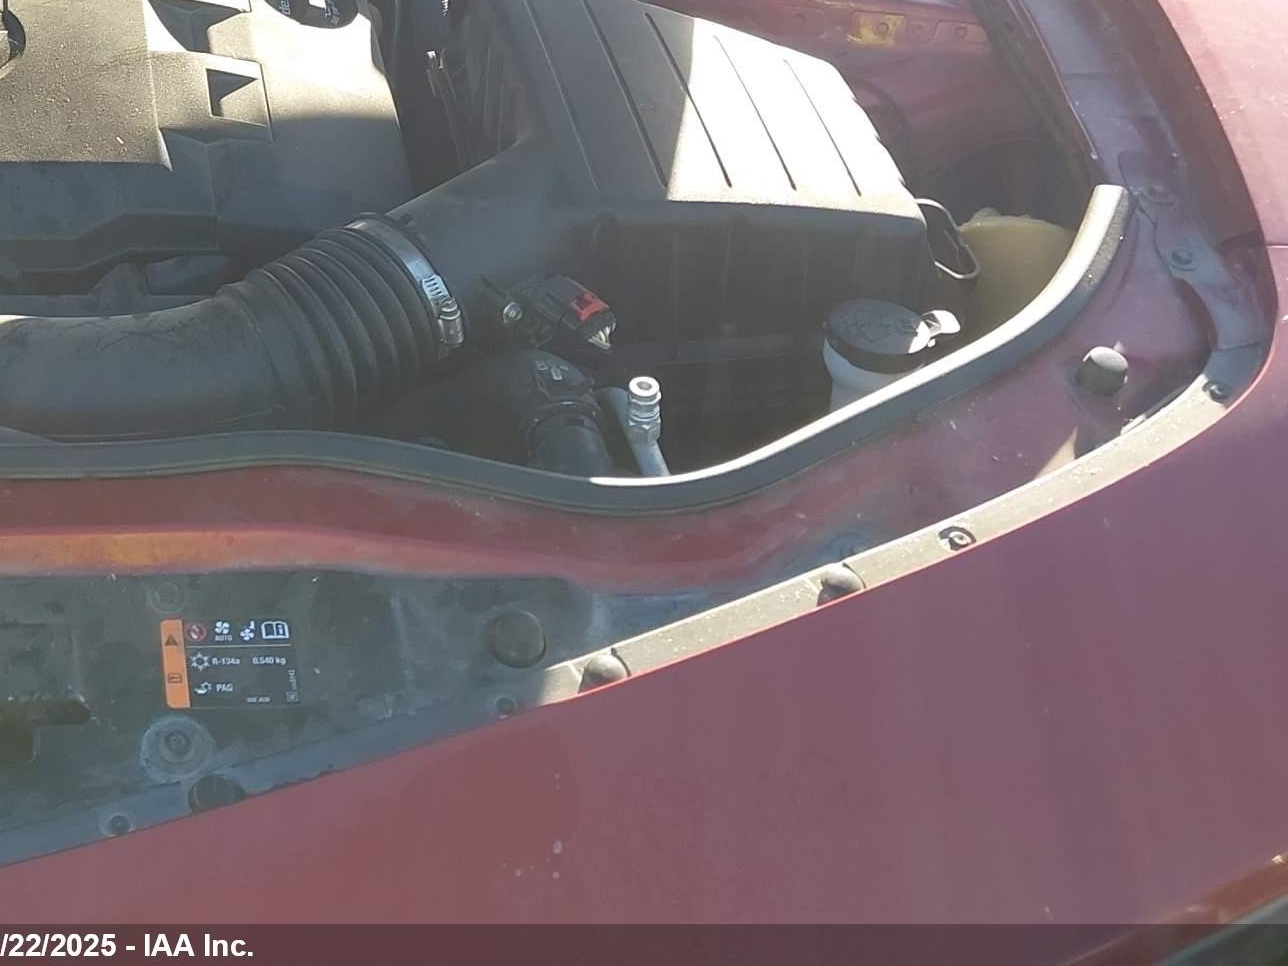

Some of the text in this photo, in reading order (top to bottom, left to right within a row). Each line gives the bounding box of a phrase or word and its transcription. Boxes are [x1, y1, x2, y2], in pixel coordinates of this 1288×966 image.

[212, 657, 241, 666] R-134a
[275, 656, 287, 666] kg
[215, 683, 234, 692] PAG
